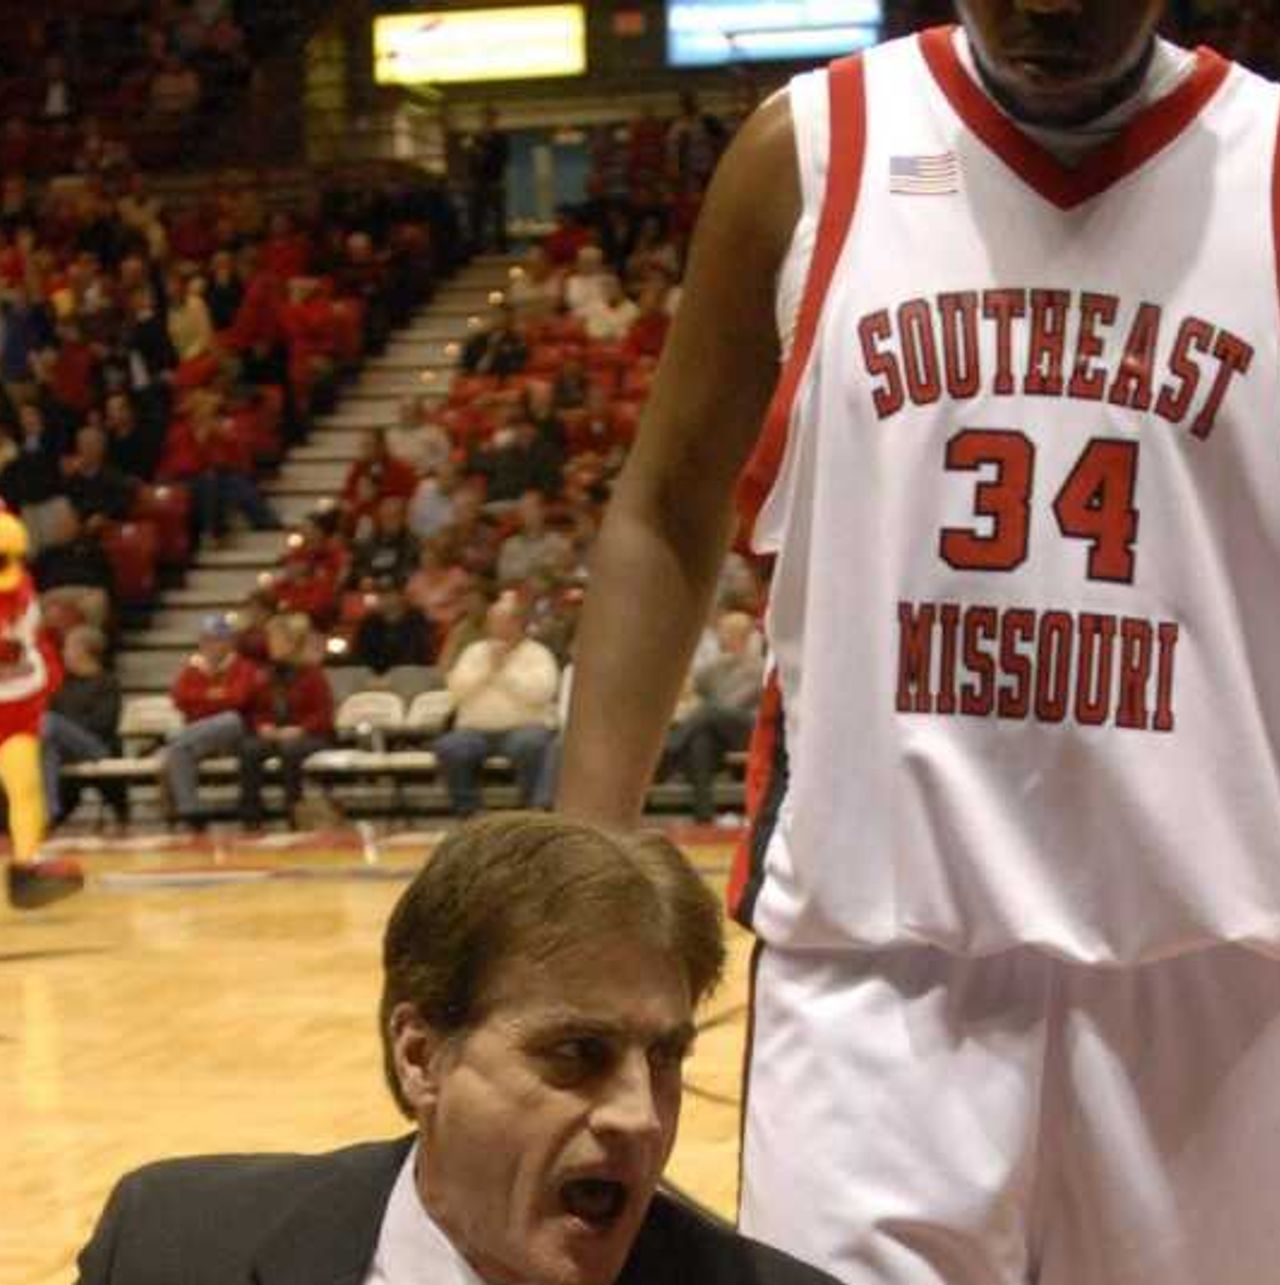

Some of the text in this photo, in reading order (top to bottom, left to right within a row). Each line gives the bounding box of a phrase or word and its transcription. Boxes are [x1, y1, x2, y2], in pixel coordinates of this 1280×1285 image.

[857, 288, 1255, 440] SOUTHEAST
[938, 428, 1140, 584] 34
[895, 601, 1179, 732] MISSOURI
